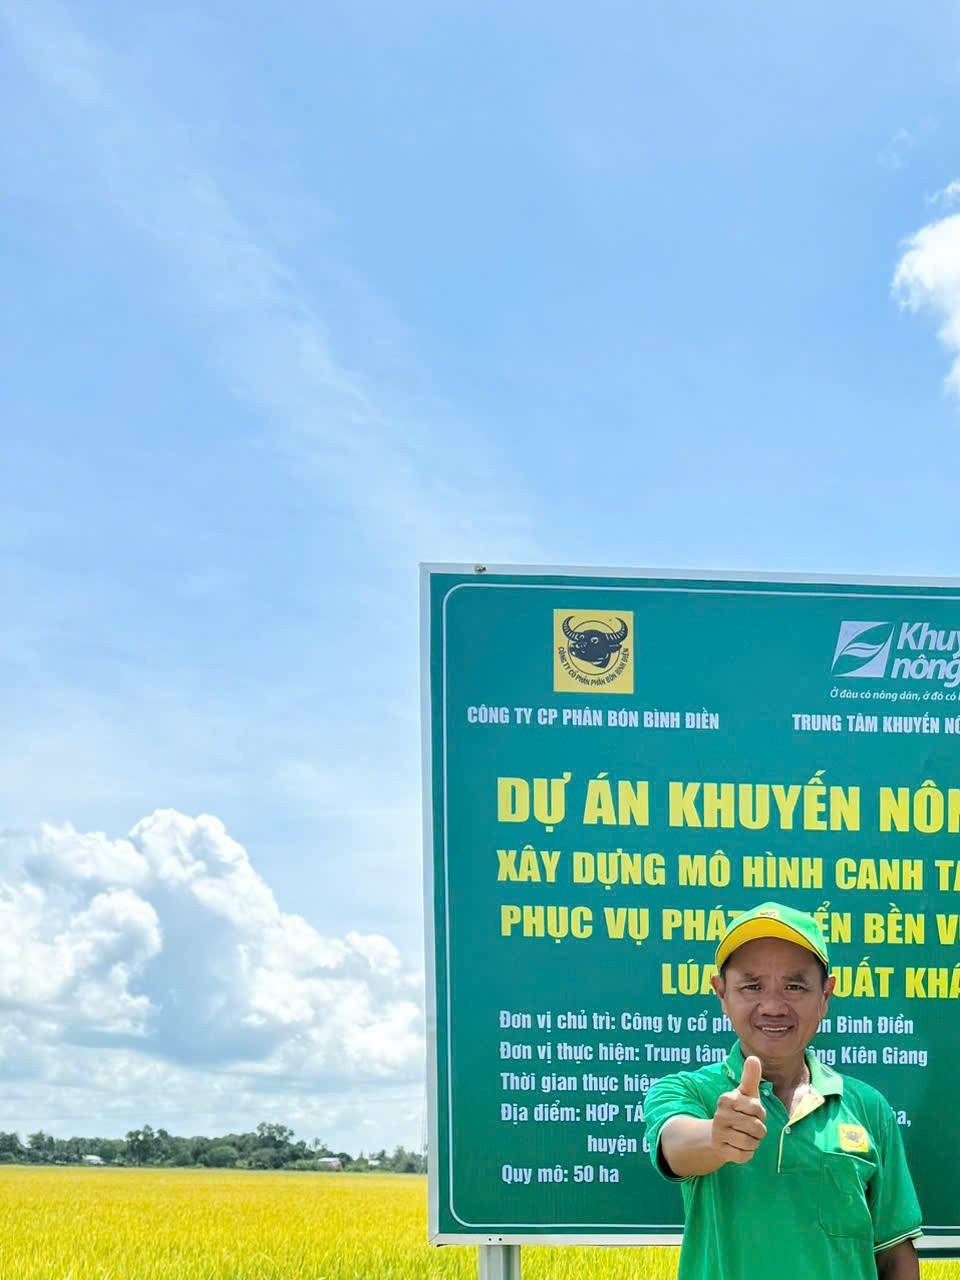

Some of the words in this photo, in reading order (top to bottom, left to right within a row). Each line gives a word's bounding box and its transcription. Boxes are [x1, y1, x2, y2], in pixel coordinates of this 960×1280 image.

[467, 706, 509, 724] CÔNG
[514, 707, 533, 724] TY
[538, 708, 558, 725] CP
[563, 707, 602, 726] PHÂN
[608, 708, 638, 727] BÓN
[644, 709, 680, 728] BÌNH
[685, 708, 719, 729] ĐIỀN
[792, 714, 842, 732] TRUNG
[847, 715, 878, 733] TÂM
[883, 712, 940, 734] KHUYẾN
[497, 771, 571, 832] DỰ
[583, 772, 649, 826] ÁN
[669, 770, 860, 832] KHUYẾN
[497, 845, 560, 882] XÂY
[573, 848, 666, 889] DỰNG
[678, 850, 731, 887] MÔ
[743, 851, 823, 889] HÌNH
[835, 858, 923, 890] CANH
[501, 905, 593, 944] PHỤC
[604, 906, 649, 946] VỤ
[864, 903, 925, 945] BỀN
[499, 1010, 532, 1030] Đơn
[535, 1012, 552, 1032] vị
[556, 1010, 587, 1030] chủ
[592, 1011, 615, 1031] trì:
[620, 1012, 663, 1034] Công
[667, 1014, 683, 1035] ty
[687, 1008, 708, 1032] cổ
[836, 1016, 872, 1035] Bình
[877, 1013, 914, 1035] Điền
[499, 1042, 532, 1060] Đơn
[535, 1043, 552, 1063] vị
[557, 1042, 594, 1064] thực
[598, 1042, 640, 1064] hiện:
[645, 1044, 692, 1065] Trung
[696, 1044, 726, 1063] tâm
[841, 1045, 877, 1065] Kiên
[882, 1047, 928, 1067] Giang
[500, 1072, 537, 1091] Thời
[541, 1072, 578, 1093] gian
[582, 1072, 619, 1094] thực
[500, 1103, 529, 1123] Địa
[534, 1100, 581, 1122] điểm:
[586, 1103, 620, 1125] HỢP
[502, 1165, 532, 1184] Quy
[537, 1165, 568, 1183] mô:
[573, 1166, 594, 1182] 50
[599, 1166, 619, 1183] ha
